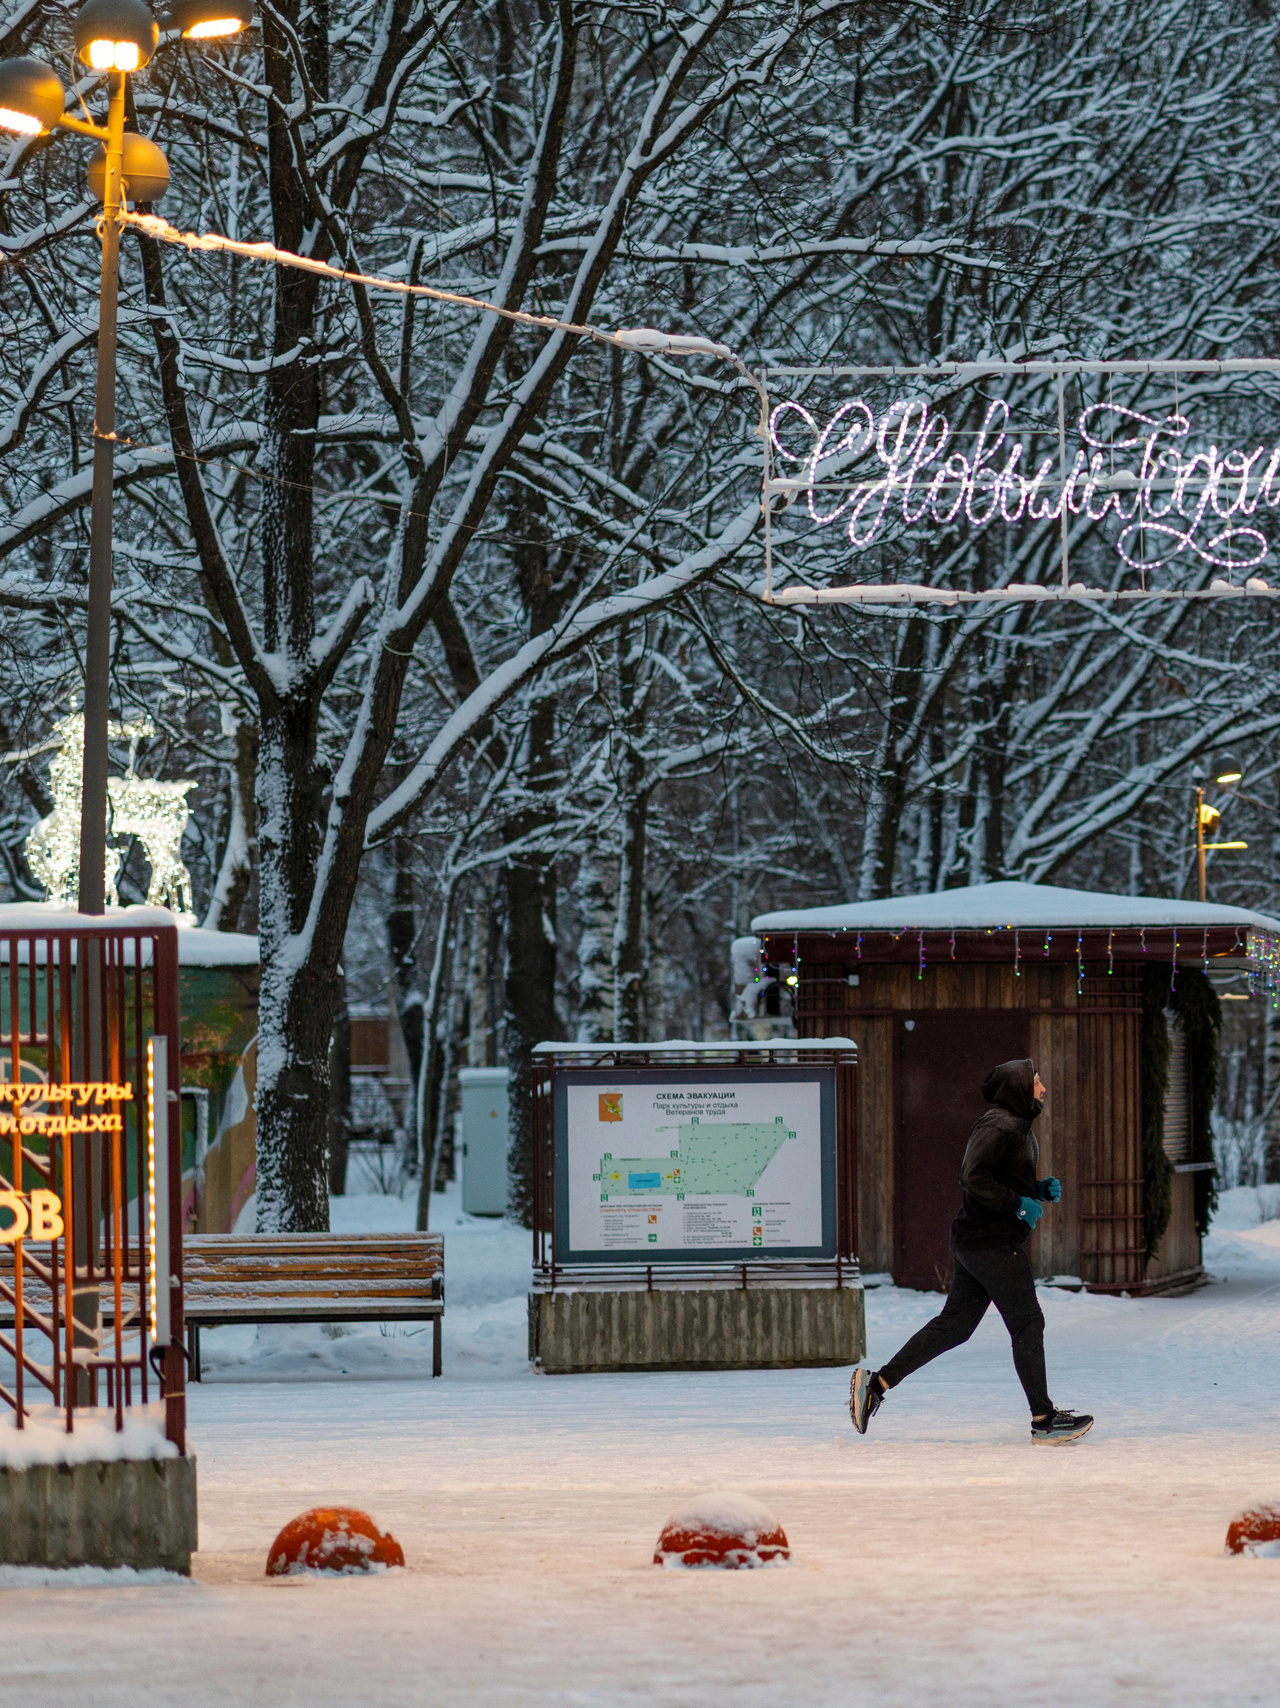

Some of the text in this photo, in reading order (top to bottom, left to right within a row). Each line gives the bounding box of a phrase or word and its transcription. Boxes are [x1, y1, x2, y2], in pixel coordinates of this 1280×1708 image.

[0, 1082, 133, 1105] культуры
[656, 1092, 735, 1100] СХЕМА ЭВАКУАЦИИ
[19, 1114, 123, 1136] отдыха
